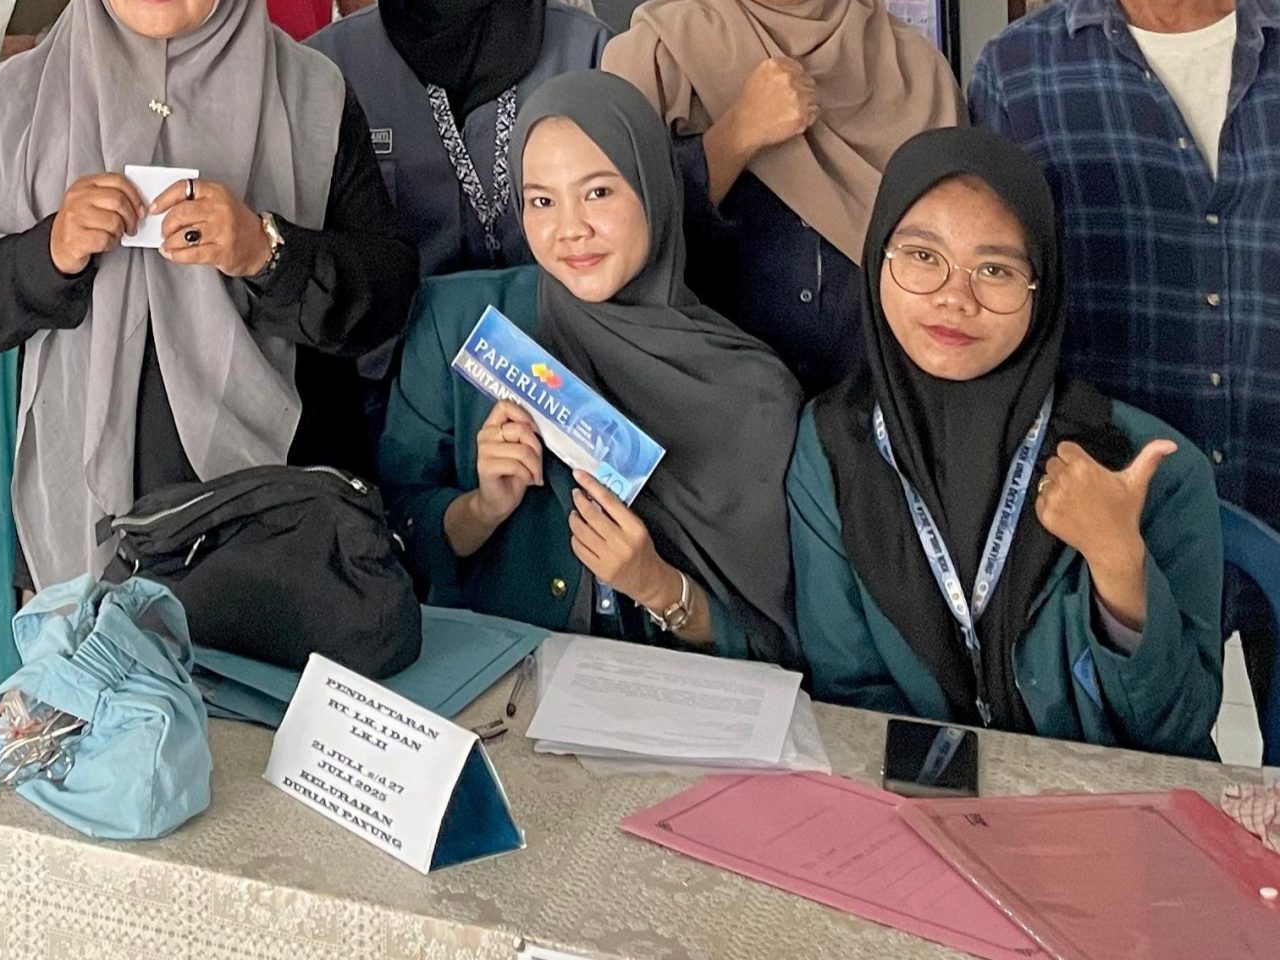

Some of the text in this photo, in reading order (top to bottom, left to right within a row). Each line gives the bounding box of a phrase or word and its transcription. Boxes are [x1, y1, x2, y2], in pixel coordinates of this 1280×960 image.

[474, 338, 571, 425] PAPERLINE
[1004, 487, 1019, 509] DESA
[325, 677, 439, 740] PENDAFTARAN
[328, 698, 350, 714] RT
[390, 731, 422, 752] DAN
[311, 740, 405, 795] 21 JULI s/d 27
[318, 760, 387, 803] JULI 2025
[283, 776, 403, 850] DURIAN PAYUNG
[300, 770, 394, 827] KELURAHAN
